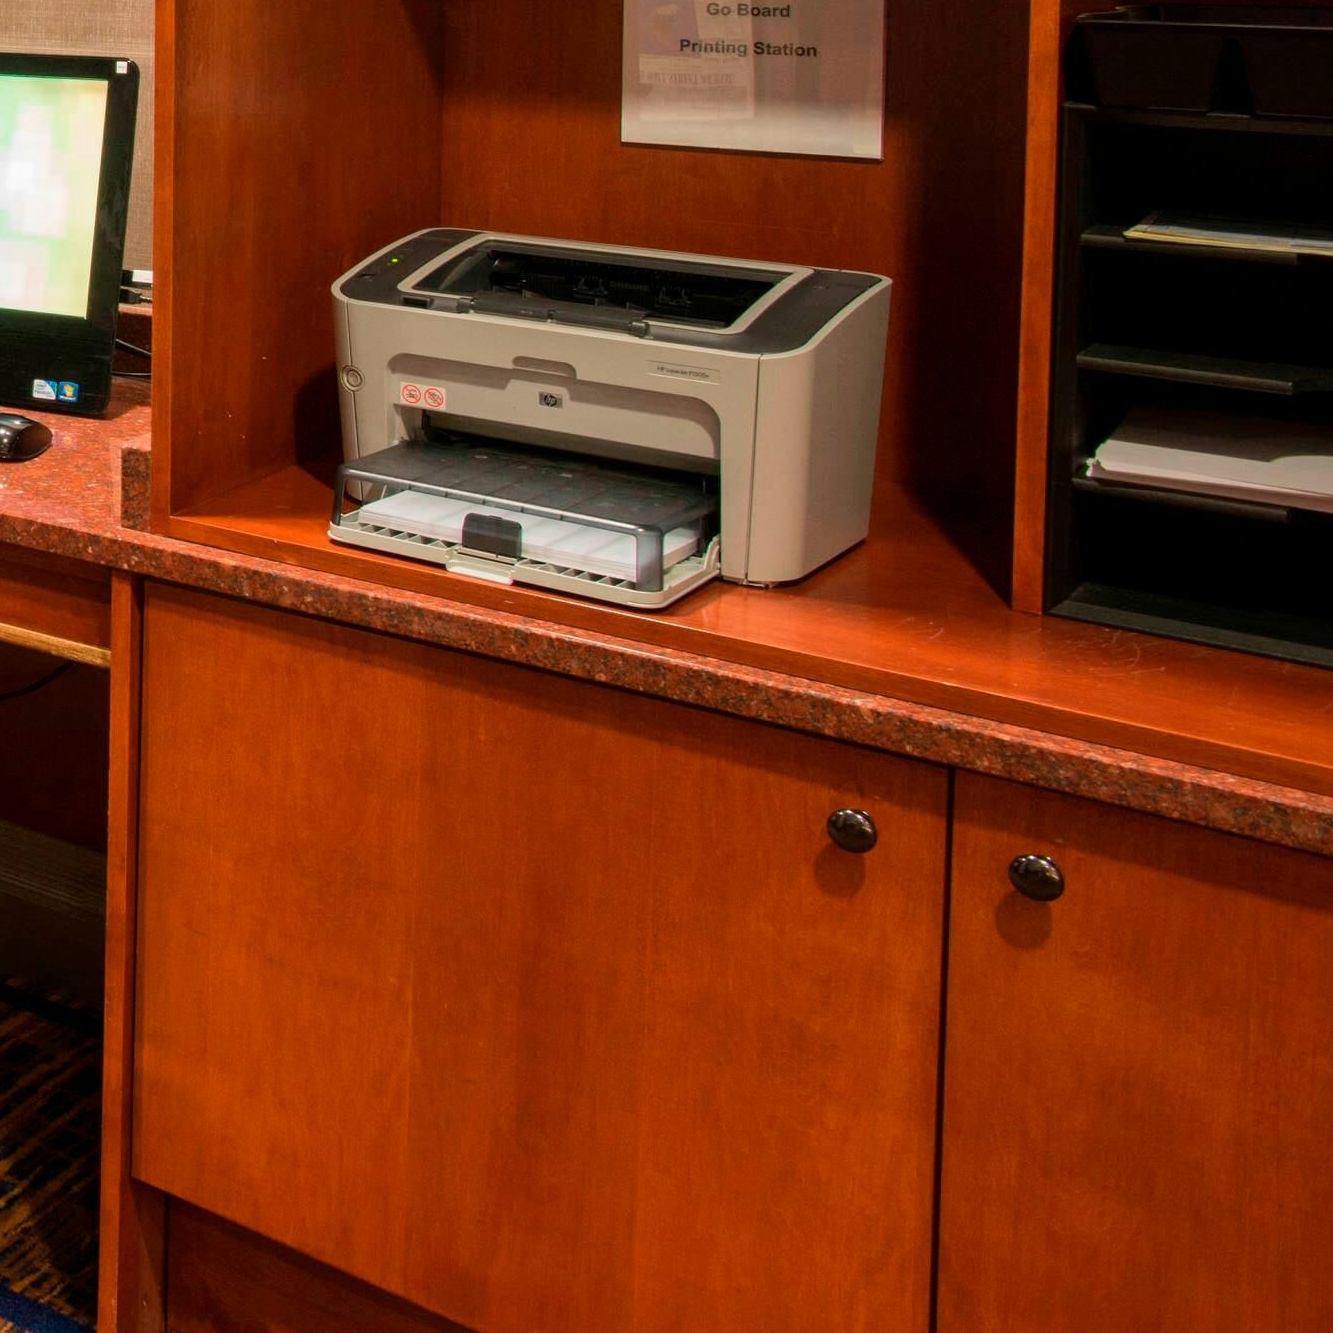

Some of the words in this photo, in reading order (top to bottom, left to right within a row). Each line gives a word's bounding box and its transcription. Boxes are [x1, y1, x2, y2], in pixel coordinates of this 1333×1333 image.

[707, 2, 731, 18] Go
[737, 2, 791, 18] Board
[679, 38, 748, 57] Printing
[753, 39, 818, 57] Station
